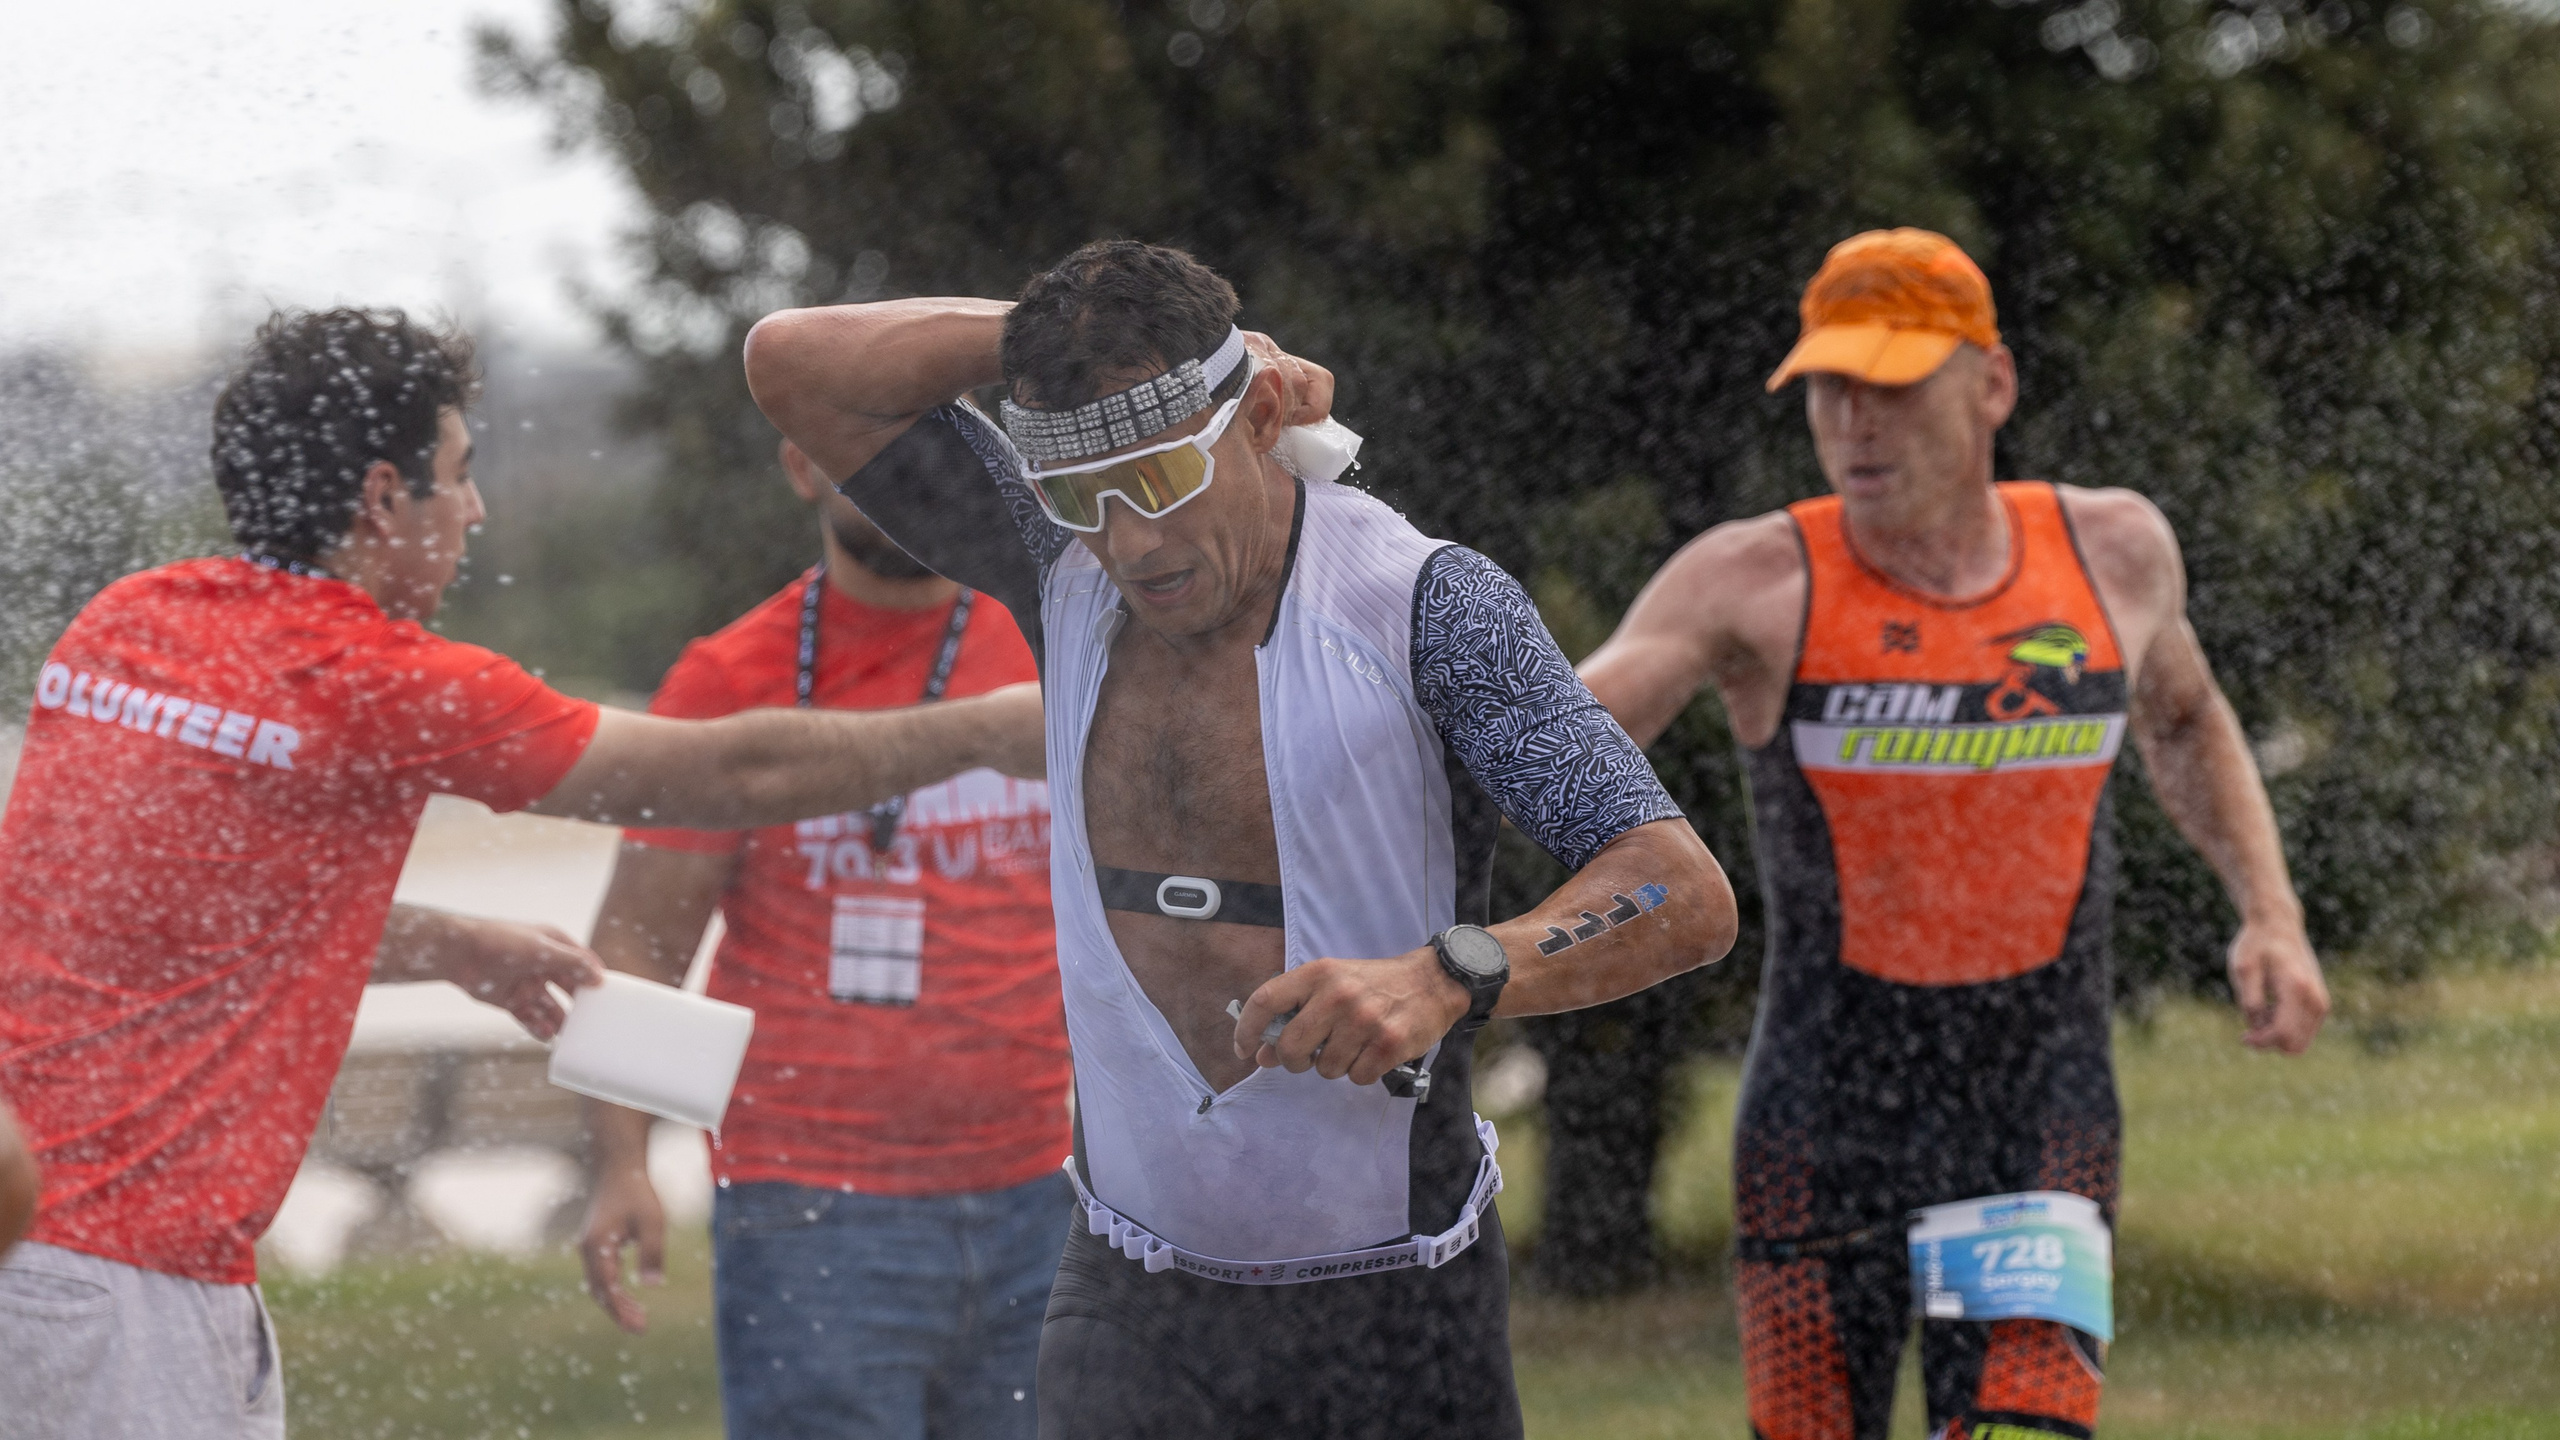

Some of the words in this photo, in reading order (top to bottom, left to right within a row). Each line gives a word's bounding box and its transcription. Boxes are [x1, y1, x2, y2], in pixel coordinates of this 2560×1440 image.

[1322, 638, 1384, 685] HUUB
[37, 661, 301, 771] OLUNTEER
[1174, 891, 1198, 899] GARMIN
[1535, 892, 1642, 957] 111
[1973, 1234, 2066, 1275] 728
